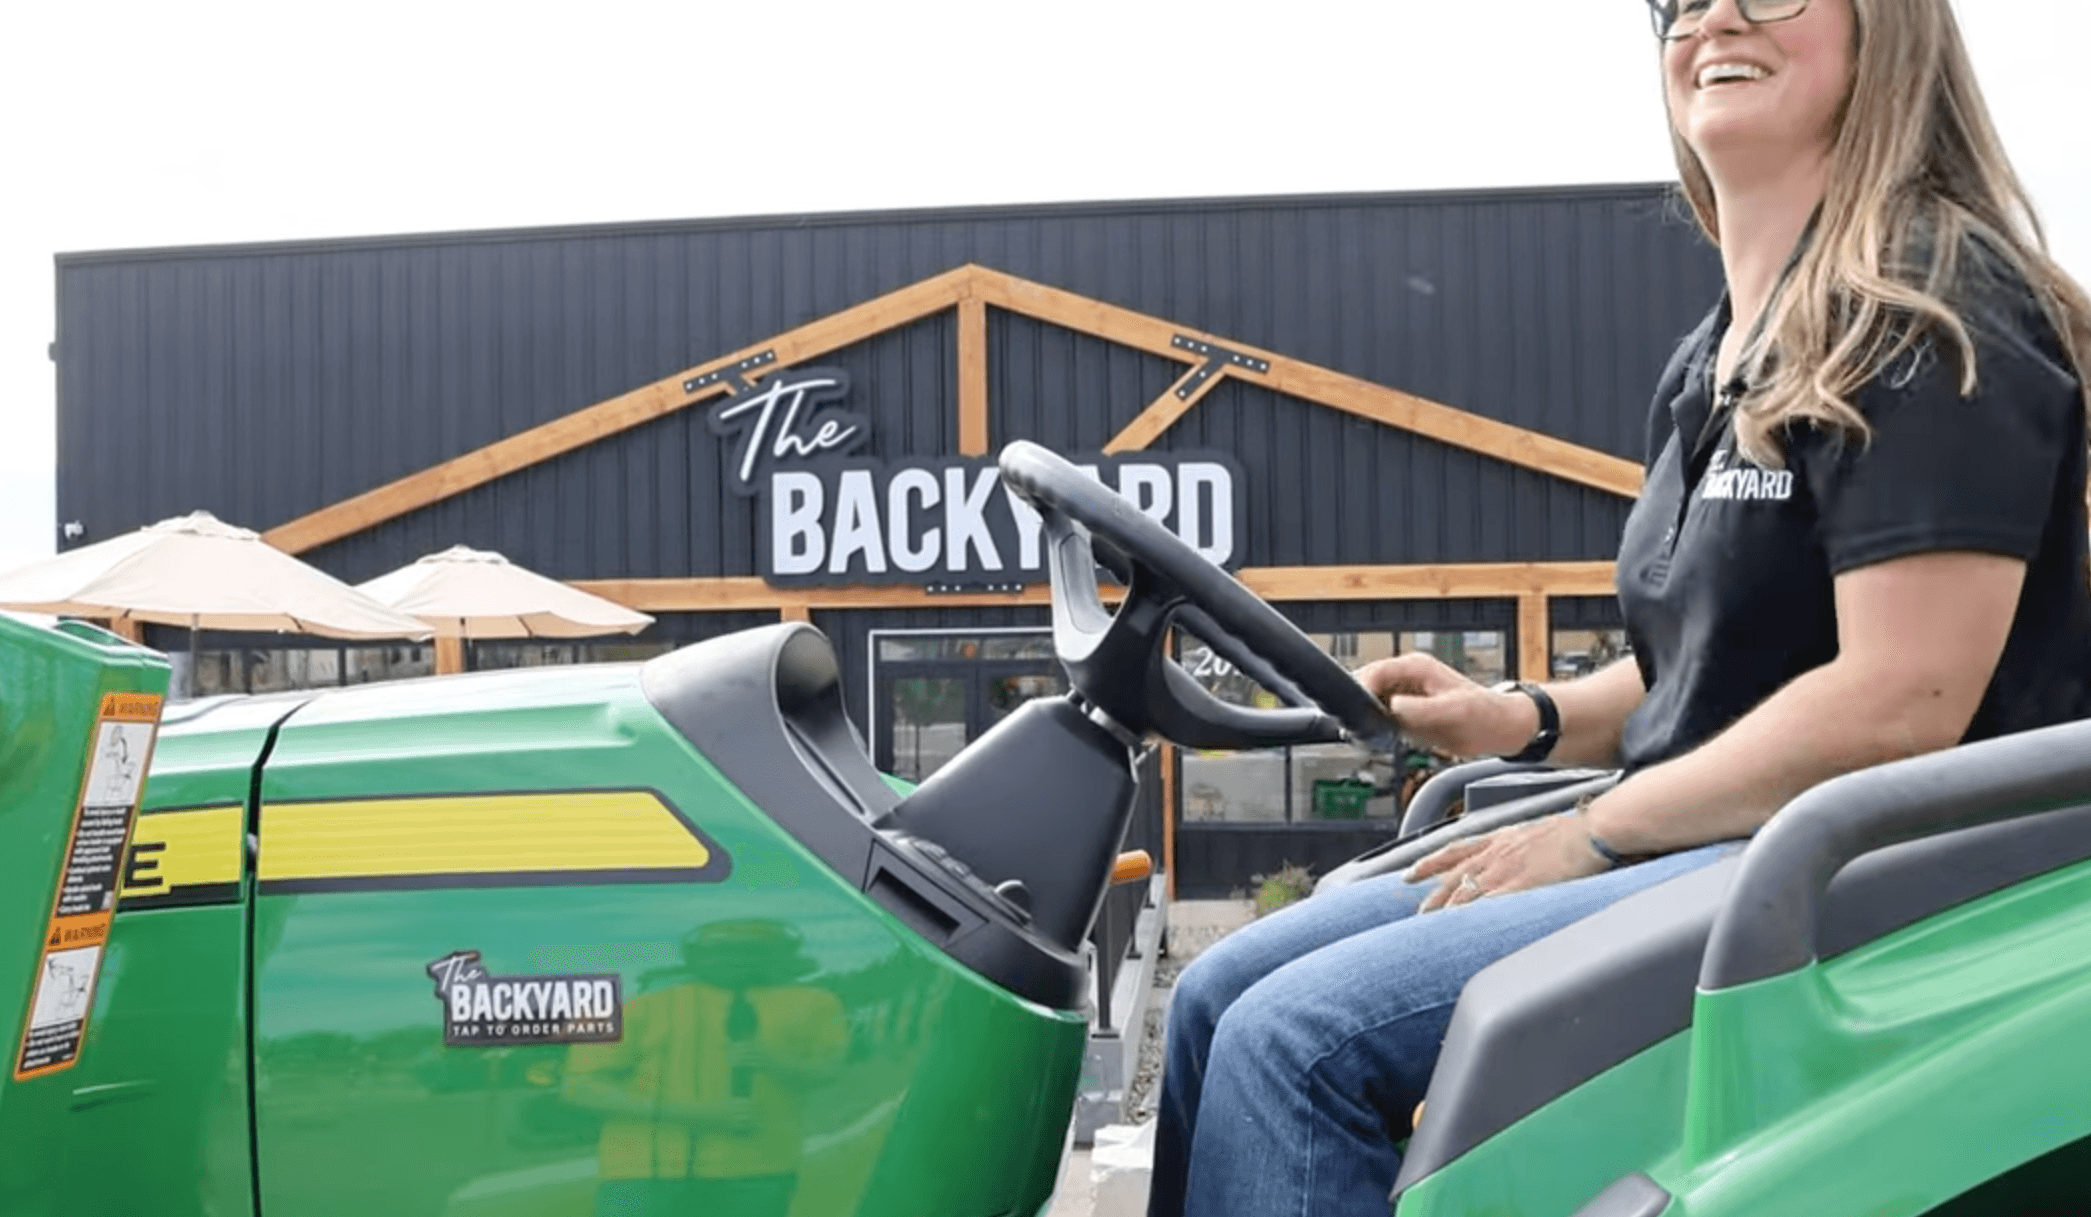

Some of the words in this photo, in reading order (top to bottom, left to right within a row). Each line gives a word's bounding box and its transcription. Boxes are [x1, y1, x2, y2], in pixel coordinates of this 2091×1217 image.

[720, 379, 856, 481] The
[772, 462, 1232, 574] BACKYRD
[431, 953, 482, 992] The
[452, 980, 614, 1021] BACKYARD
[453, 1024, 480, 1036] TAP
[486, 1024, 507, 1035] TO
[511, 1023, 560, 1035] ORDER
[567, 1022, 614, 1034] PARTS
